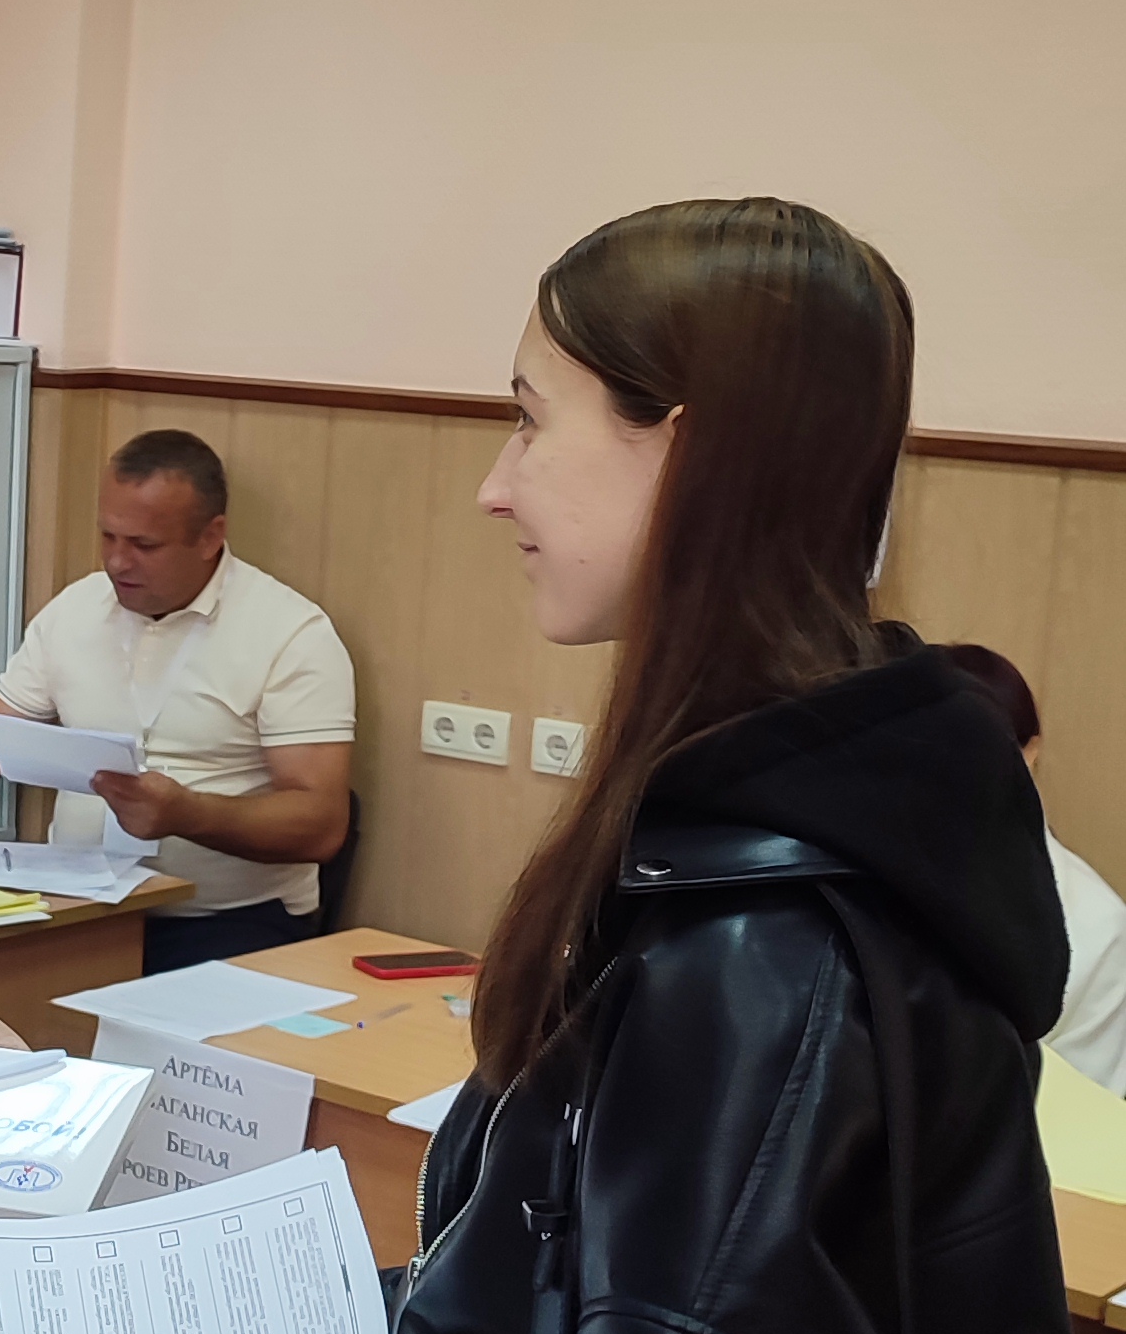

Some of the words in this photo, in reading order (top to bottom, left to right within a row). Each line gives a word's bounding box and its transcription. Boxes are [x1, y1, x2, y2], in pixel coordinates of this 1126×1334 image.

[161, 1054, 245, 1097] АРТЁМА
[150, 1094, 260, 1141] АГАНСКАЯ
[165, 1129, 231, 1170] БЕЛАЯ
[122, 1158, 169, 1188] РОЕВ
